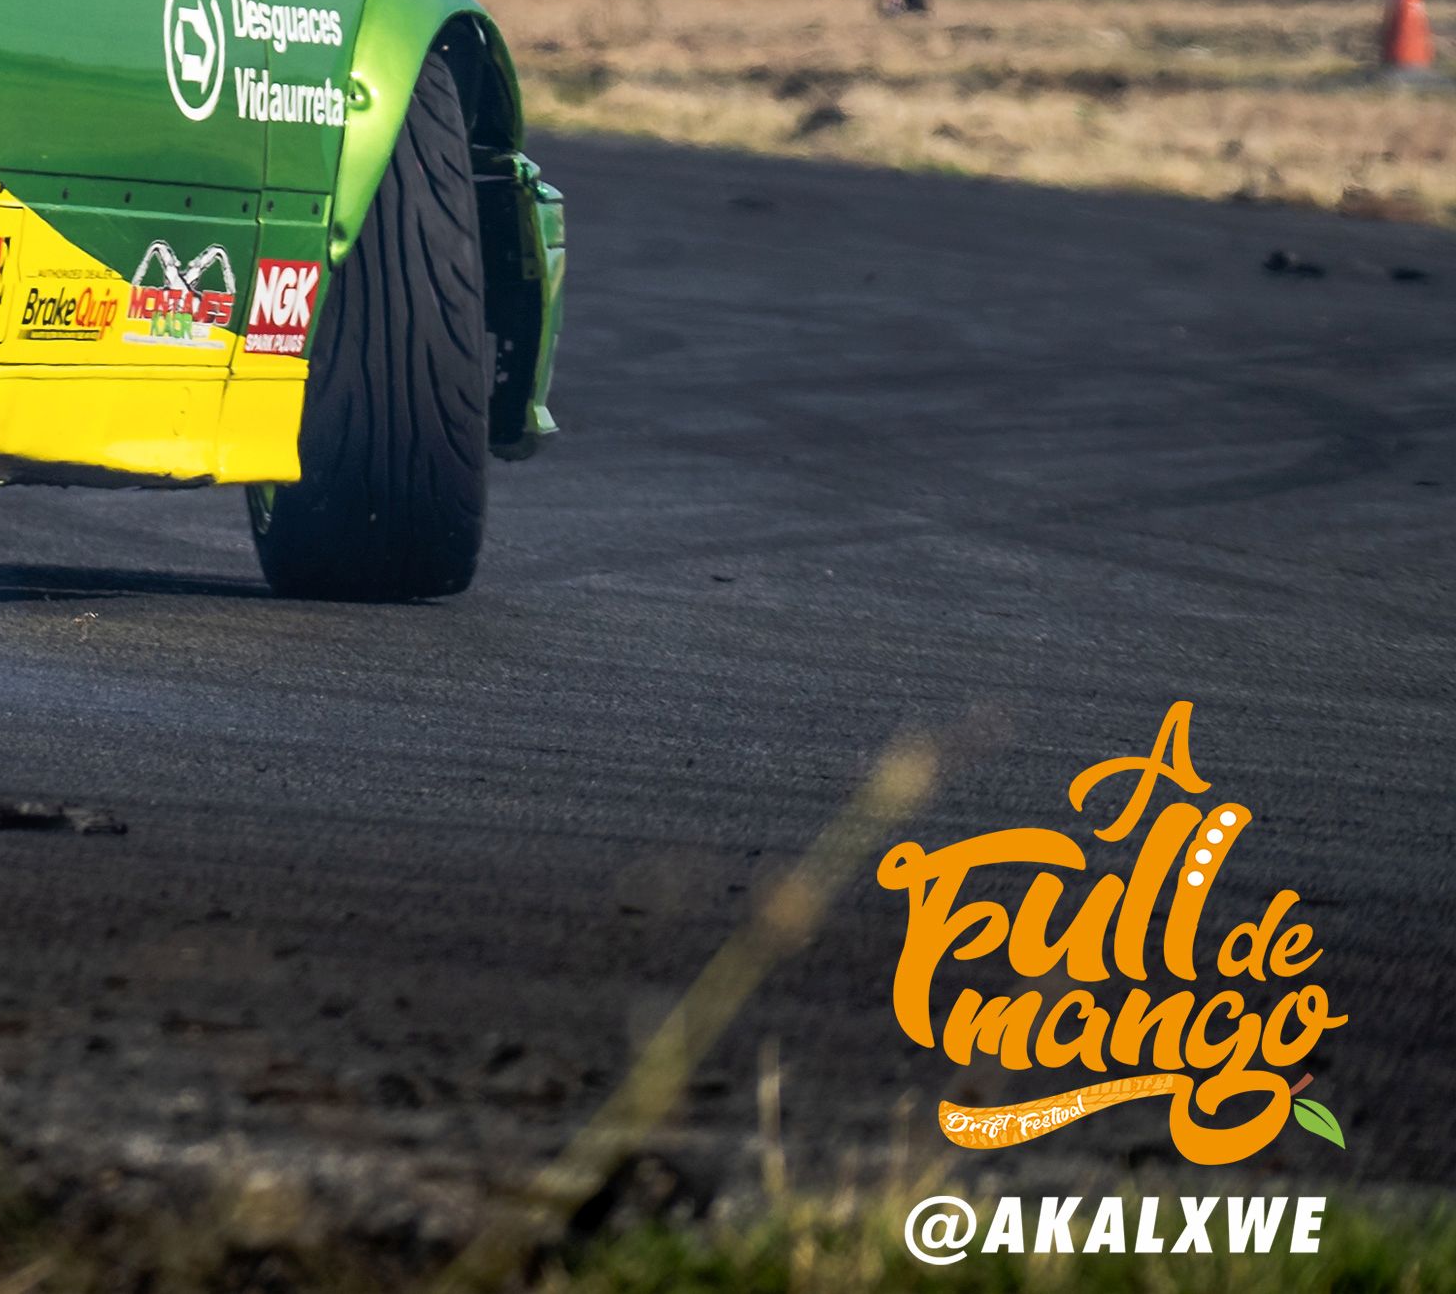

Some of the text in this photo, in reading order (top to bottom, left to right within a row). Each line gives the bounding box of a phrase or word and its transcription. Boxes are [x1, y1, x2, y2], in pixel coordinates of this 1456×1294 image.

[234, 67, 345, 127] Vidaurreta
[21, 286, 119, 341] BrakeQuip
[249, 266, 319, 328] NGK
[246, 333, 275, 353] SPARK
[272, 334, 306, 355] PLUGS
